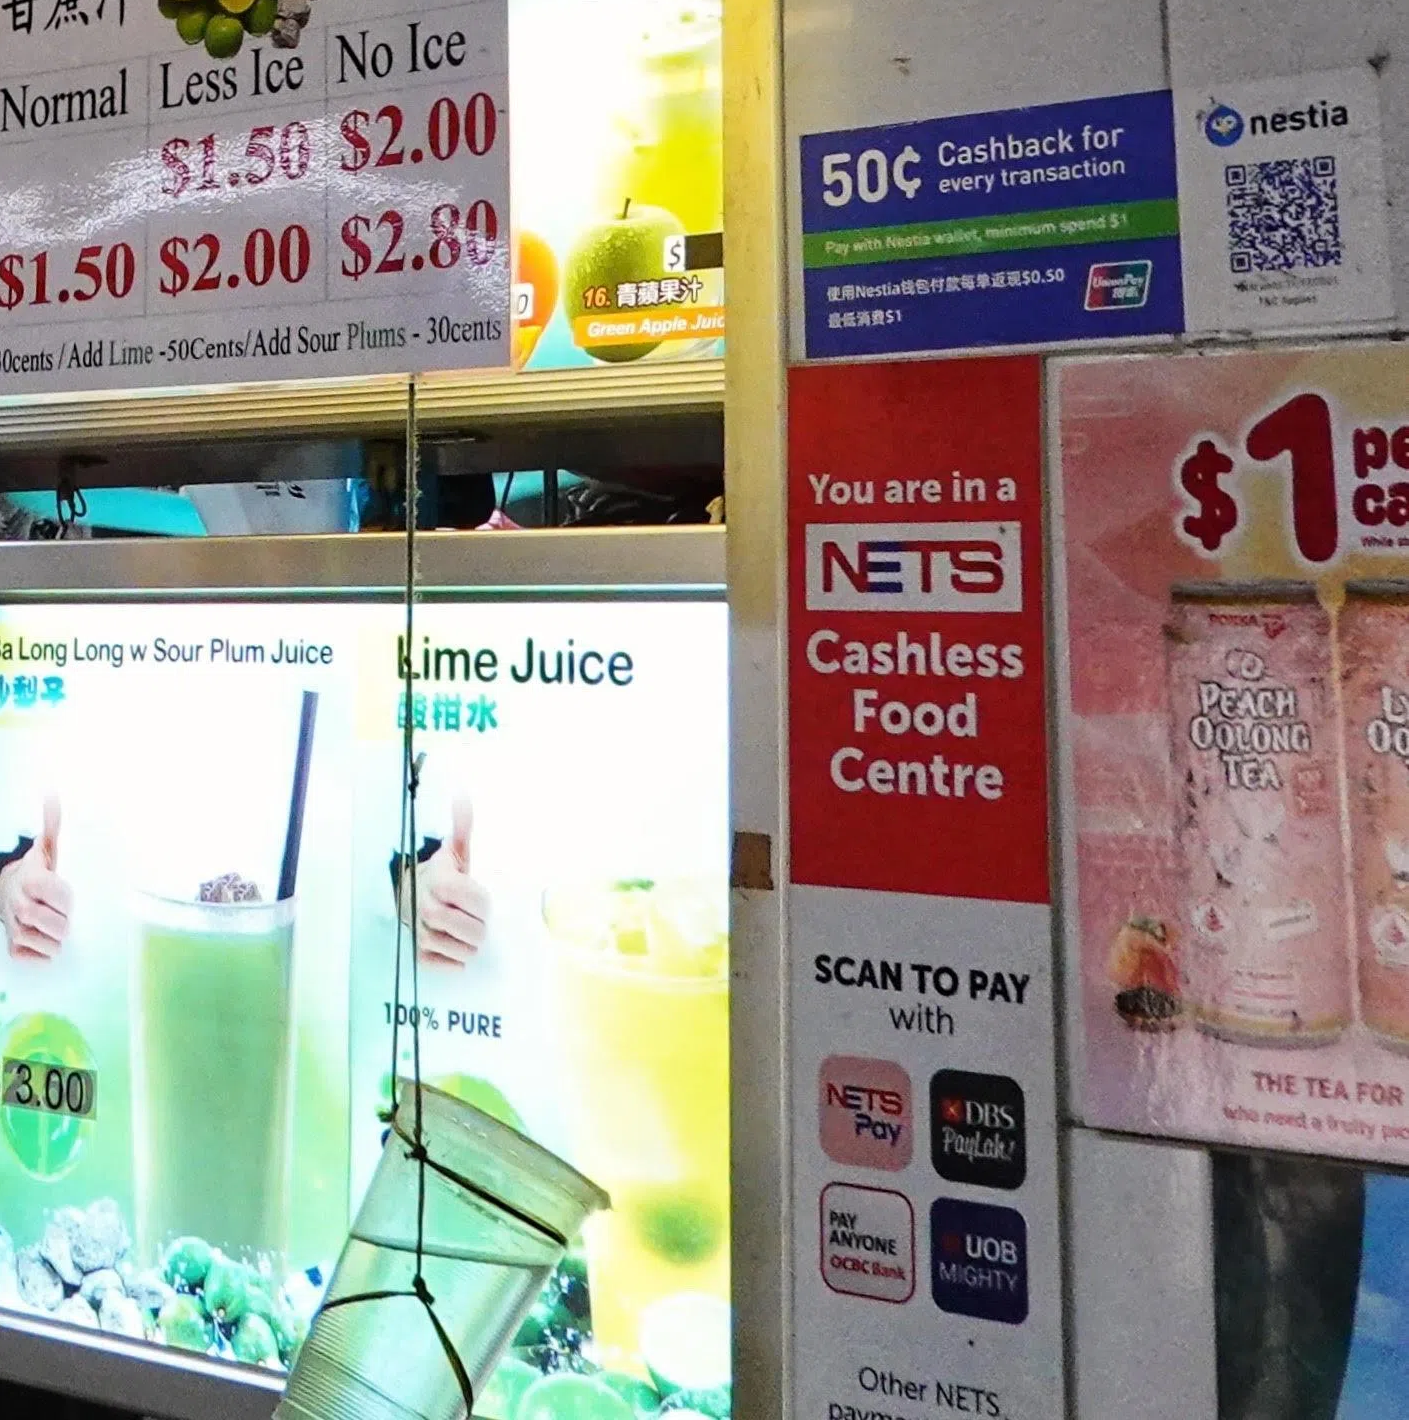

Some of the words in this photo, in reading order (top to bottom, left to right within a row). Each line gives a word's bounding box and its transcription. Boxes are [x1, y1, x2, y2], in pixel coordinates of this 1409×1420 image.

[0, 69, 130, 134] Normal
[160, 54, 239, 110] Less
[251, 46, 305, 97] Ice
[336, 33, 394, 85] No
[407, 21, 467, 73] Ice
[1249, 100, 1350, 136] nestia
[160, 120, 312, 198] $1.50
[340, 91, 498, 174] $2.00
[937, 126, 1074, 168] Cashback
[1081, 124, 1125, 150] for
[821, 145, 924, 209] 50¢
[938, 169, 995, 196] every
[1000, 155, 1126, 188] transaction
[158, 222, 312, 298] $2.00
[340, 198, 498, 280] $2.80
[985, 221, 1057, 239] minimum
[583, 284, 612, 309] 16.
[616, 277, 703, 311] 青蘋果汁
[107, 337, 154, 367] Lime
[297, 323, 341, 356] Sour
[346, 319, 406, 353] Plums
[427, 315, 502, 346] 30cents
[587, 318, 636, 340] Green
[639, 315, 686, 340] Apple
[808, 474, 876, 506] You
[883, 477, 943, 505] are
[951, 469, 986, 504] in
[997, 479, 1018, 503] a
[1181, 392, 1340, 563] $1
[821, 538, 1004, 595] NETS
[18, 636, 68, 668] Long
[73, 637, 123, 668] Long
[153, 637, 204, 663] Sour
[210, 638, 266, 664] Plum
[271, 638, 334, 665] Juice
[397, 634, 498, 682] Lime
[510, 636, 634, 686] Juice
[806, 629, 1026, 680] Cashless
[852, 688, 979, 739] Food
[1198, 681, 1297, 719] PEACH
[1190, 716, 1311, 754] OOLONG
[829, 747, 1005, 801] Centre
[1222, 750, 1282, 791] TEA
[813, 953, 903, 993] SCAN
[909, 963, 961, 998] TO
[969, 969, 1031, 1006] PAY
[384, 1000, 441, 1032] 100%
[447, 1011, 502, 1040] PURE
[888, 1001, 956, 1038] with
[827, 1083, 903, 1117] NETS
[1252, 1069, 1300, 1096] THE
[1303, 1075, 1349, 1101] TEA
[1355, 1080, 1405, 1107] FOR
[854, 1113, 903, 1147] Pay
[965, 1100, 1016, 1130] DBS
[829, 1227, 898, 1257] ANYONE
[965, 1234, 1019, 1266] UOB
[938, 1260, 1020, 1293] MIGHTY
[858, 1366, 928, 1403] Other
[935, 1381, 1002, 1418] NETS
